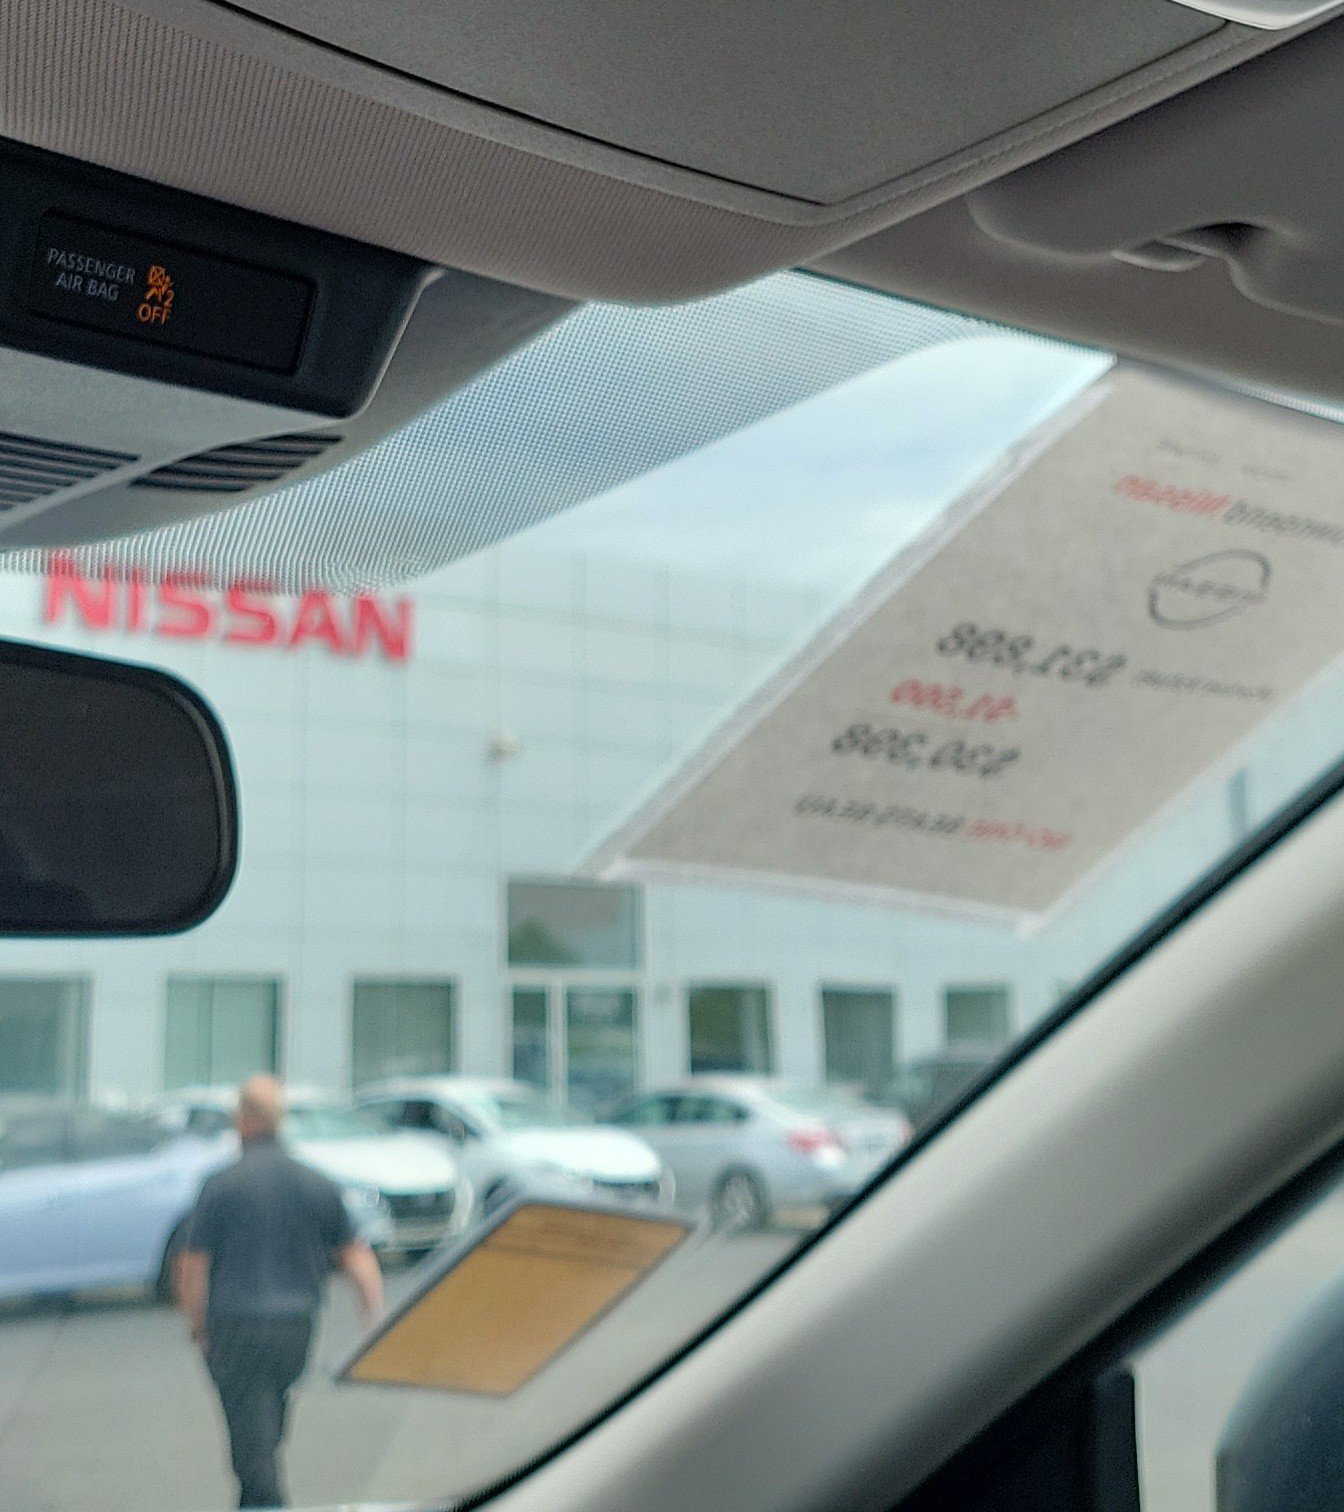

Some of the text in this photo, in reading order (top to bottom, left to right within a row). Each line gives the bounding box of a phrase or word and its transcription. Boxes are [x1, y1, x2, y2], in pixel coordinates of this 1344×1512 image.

[47, 247, 136, 284] PASSENGER
[56, 272, 120, 302] AIR BAG
[45, 551, 414, 662] NISSAN
